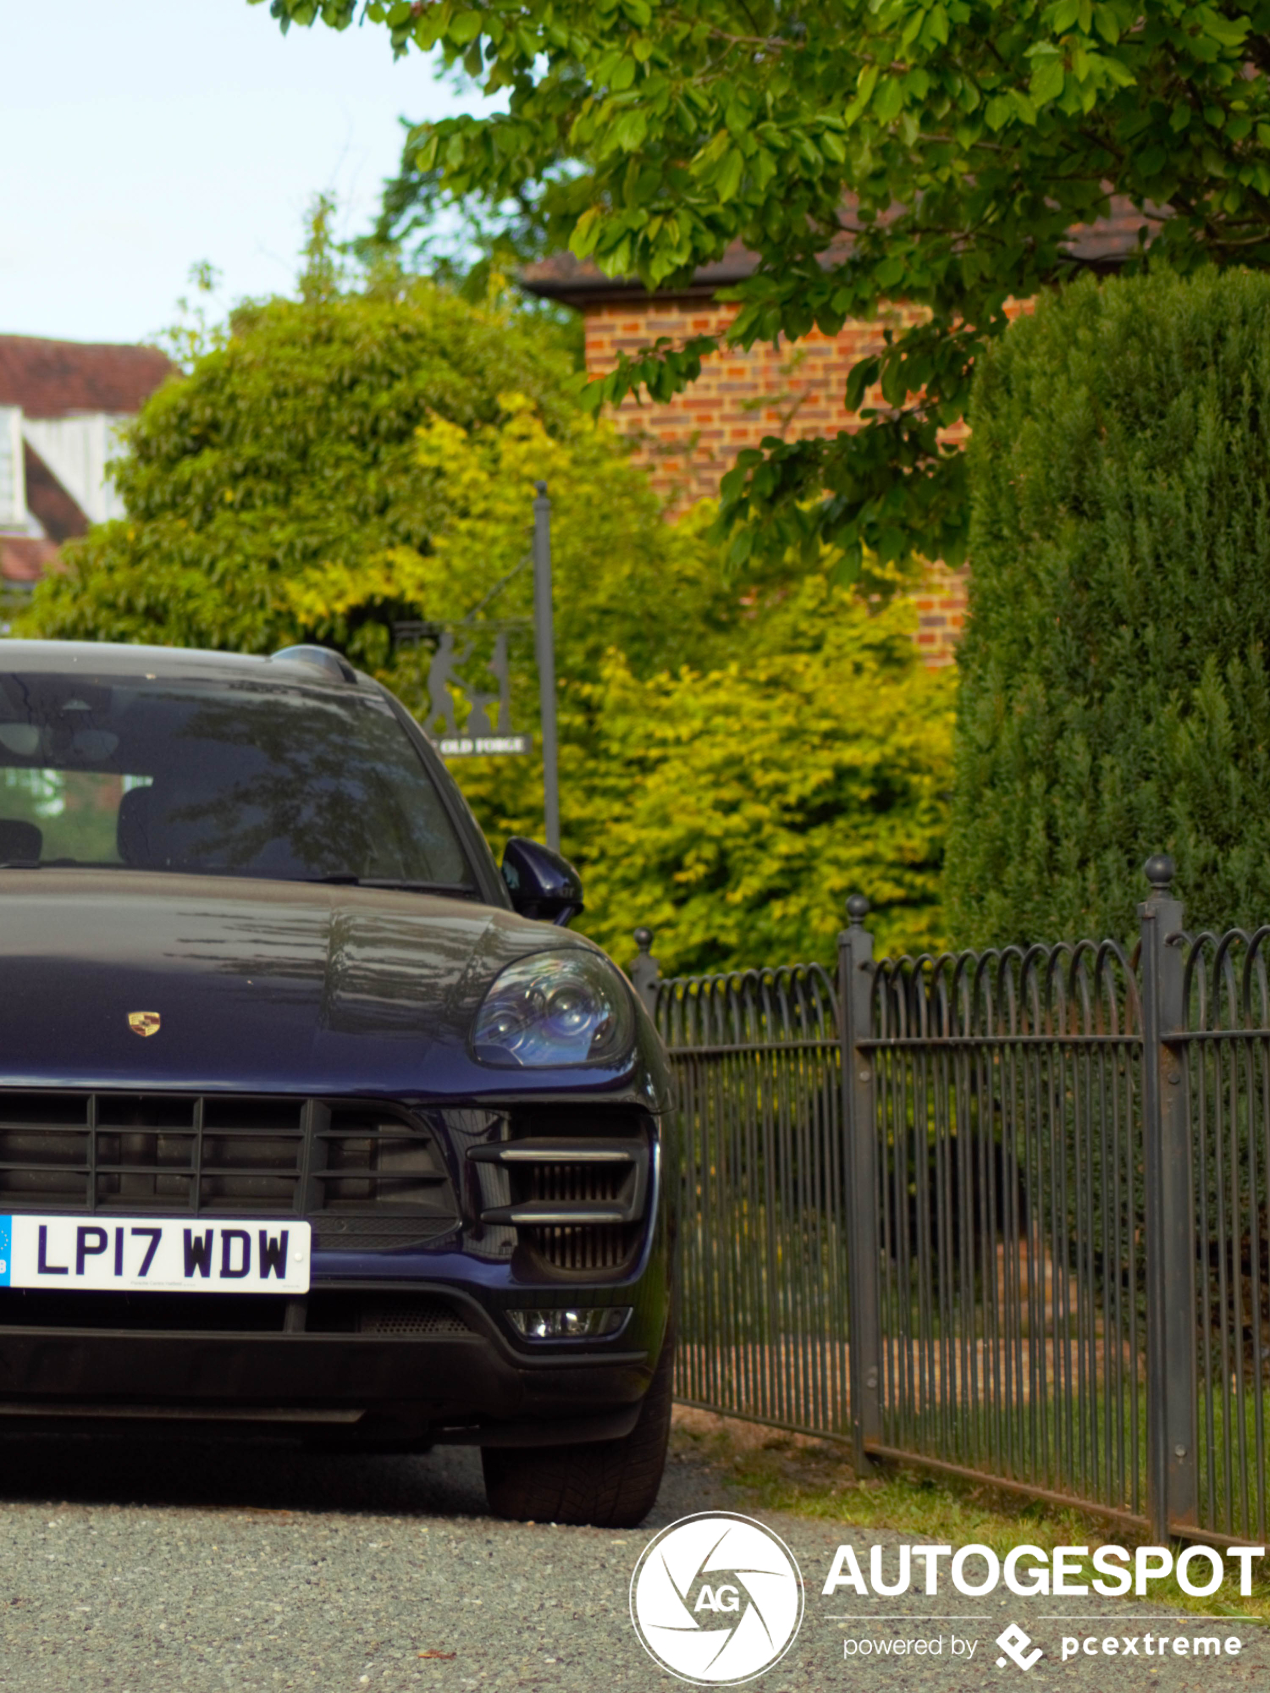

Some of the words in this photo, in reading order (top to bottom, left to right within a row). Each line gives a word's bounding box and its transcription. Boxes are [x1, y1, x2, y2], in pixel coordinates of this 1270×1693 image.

[441, 739, 473, 754] OLD
[475, 737, 525, 753] FORGE
[38, 1225, 162, 1277] LP17
[183, 1228, 289, 1279] WDW
